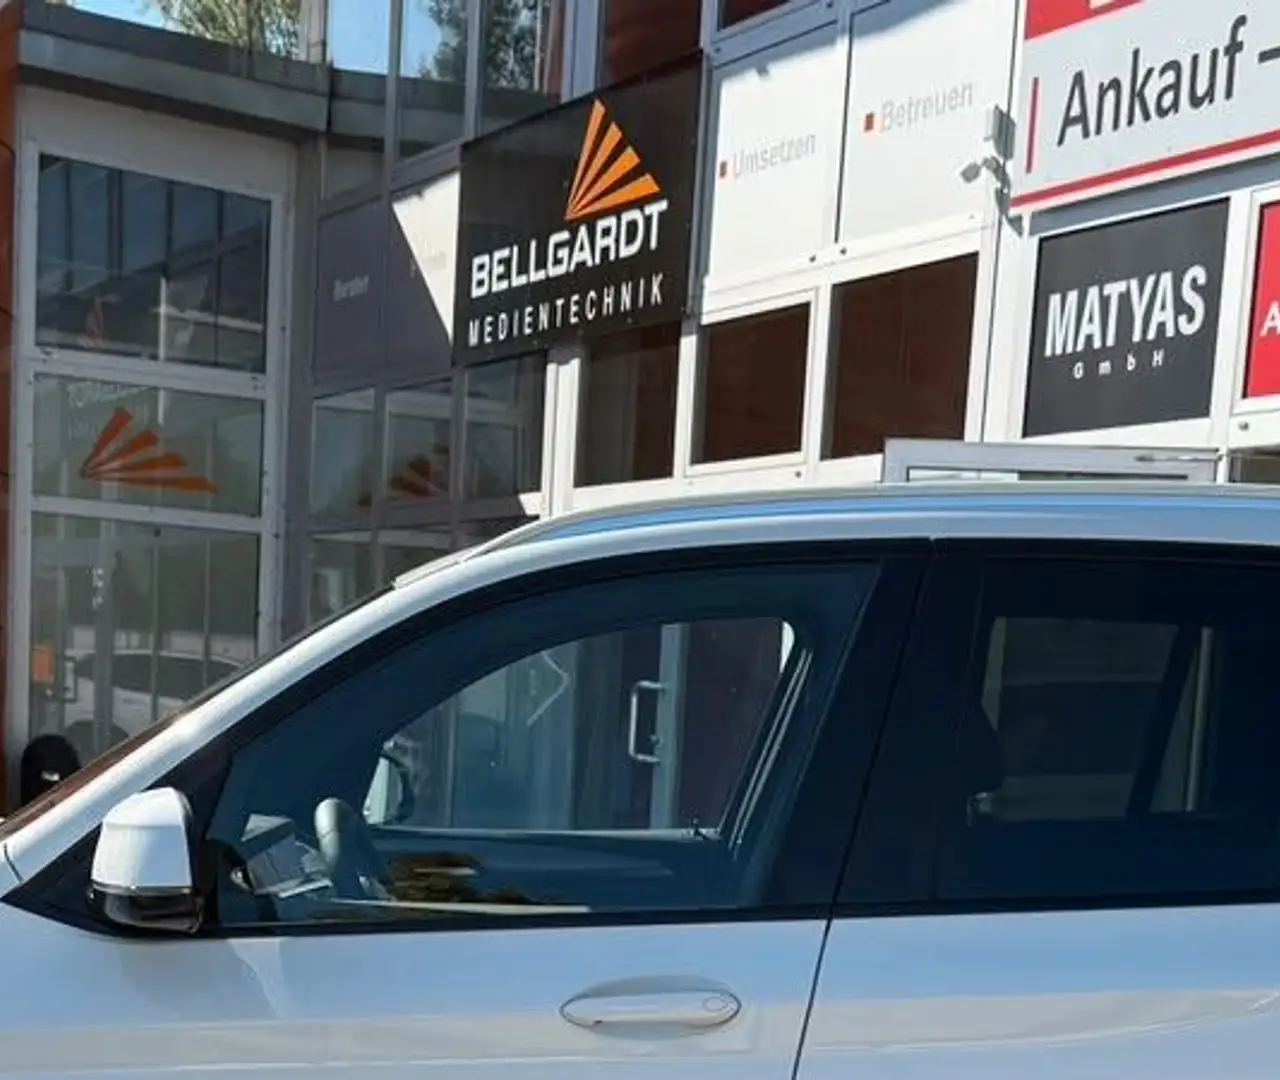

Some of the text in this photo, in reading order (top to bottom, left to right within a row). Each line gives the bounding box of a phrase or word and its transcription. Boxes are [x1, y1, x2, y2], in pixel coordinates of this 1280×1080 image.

[882, 82, 973, 132] Betreuen
[1057, 15, 1247, 147] Ankauf
[732, 133, 816, 178] Umsetzen
[470, 199, 668, 299] BELLGARDT
[469, 272, 663, 347] MEDIENTECHNIK
[1044, 264, 1208, 358] MATYAS
[1073, 348, 1165, 380] GmbH
